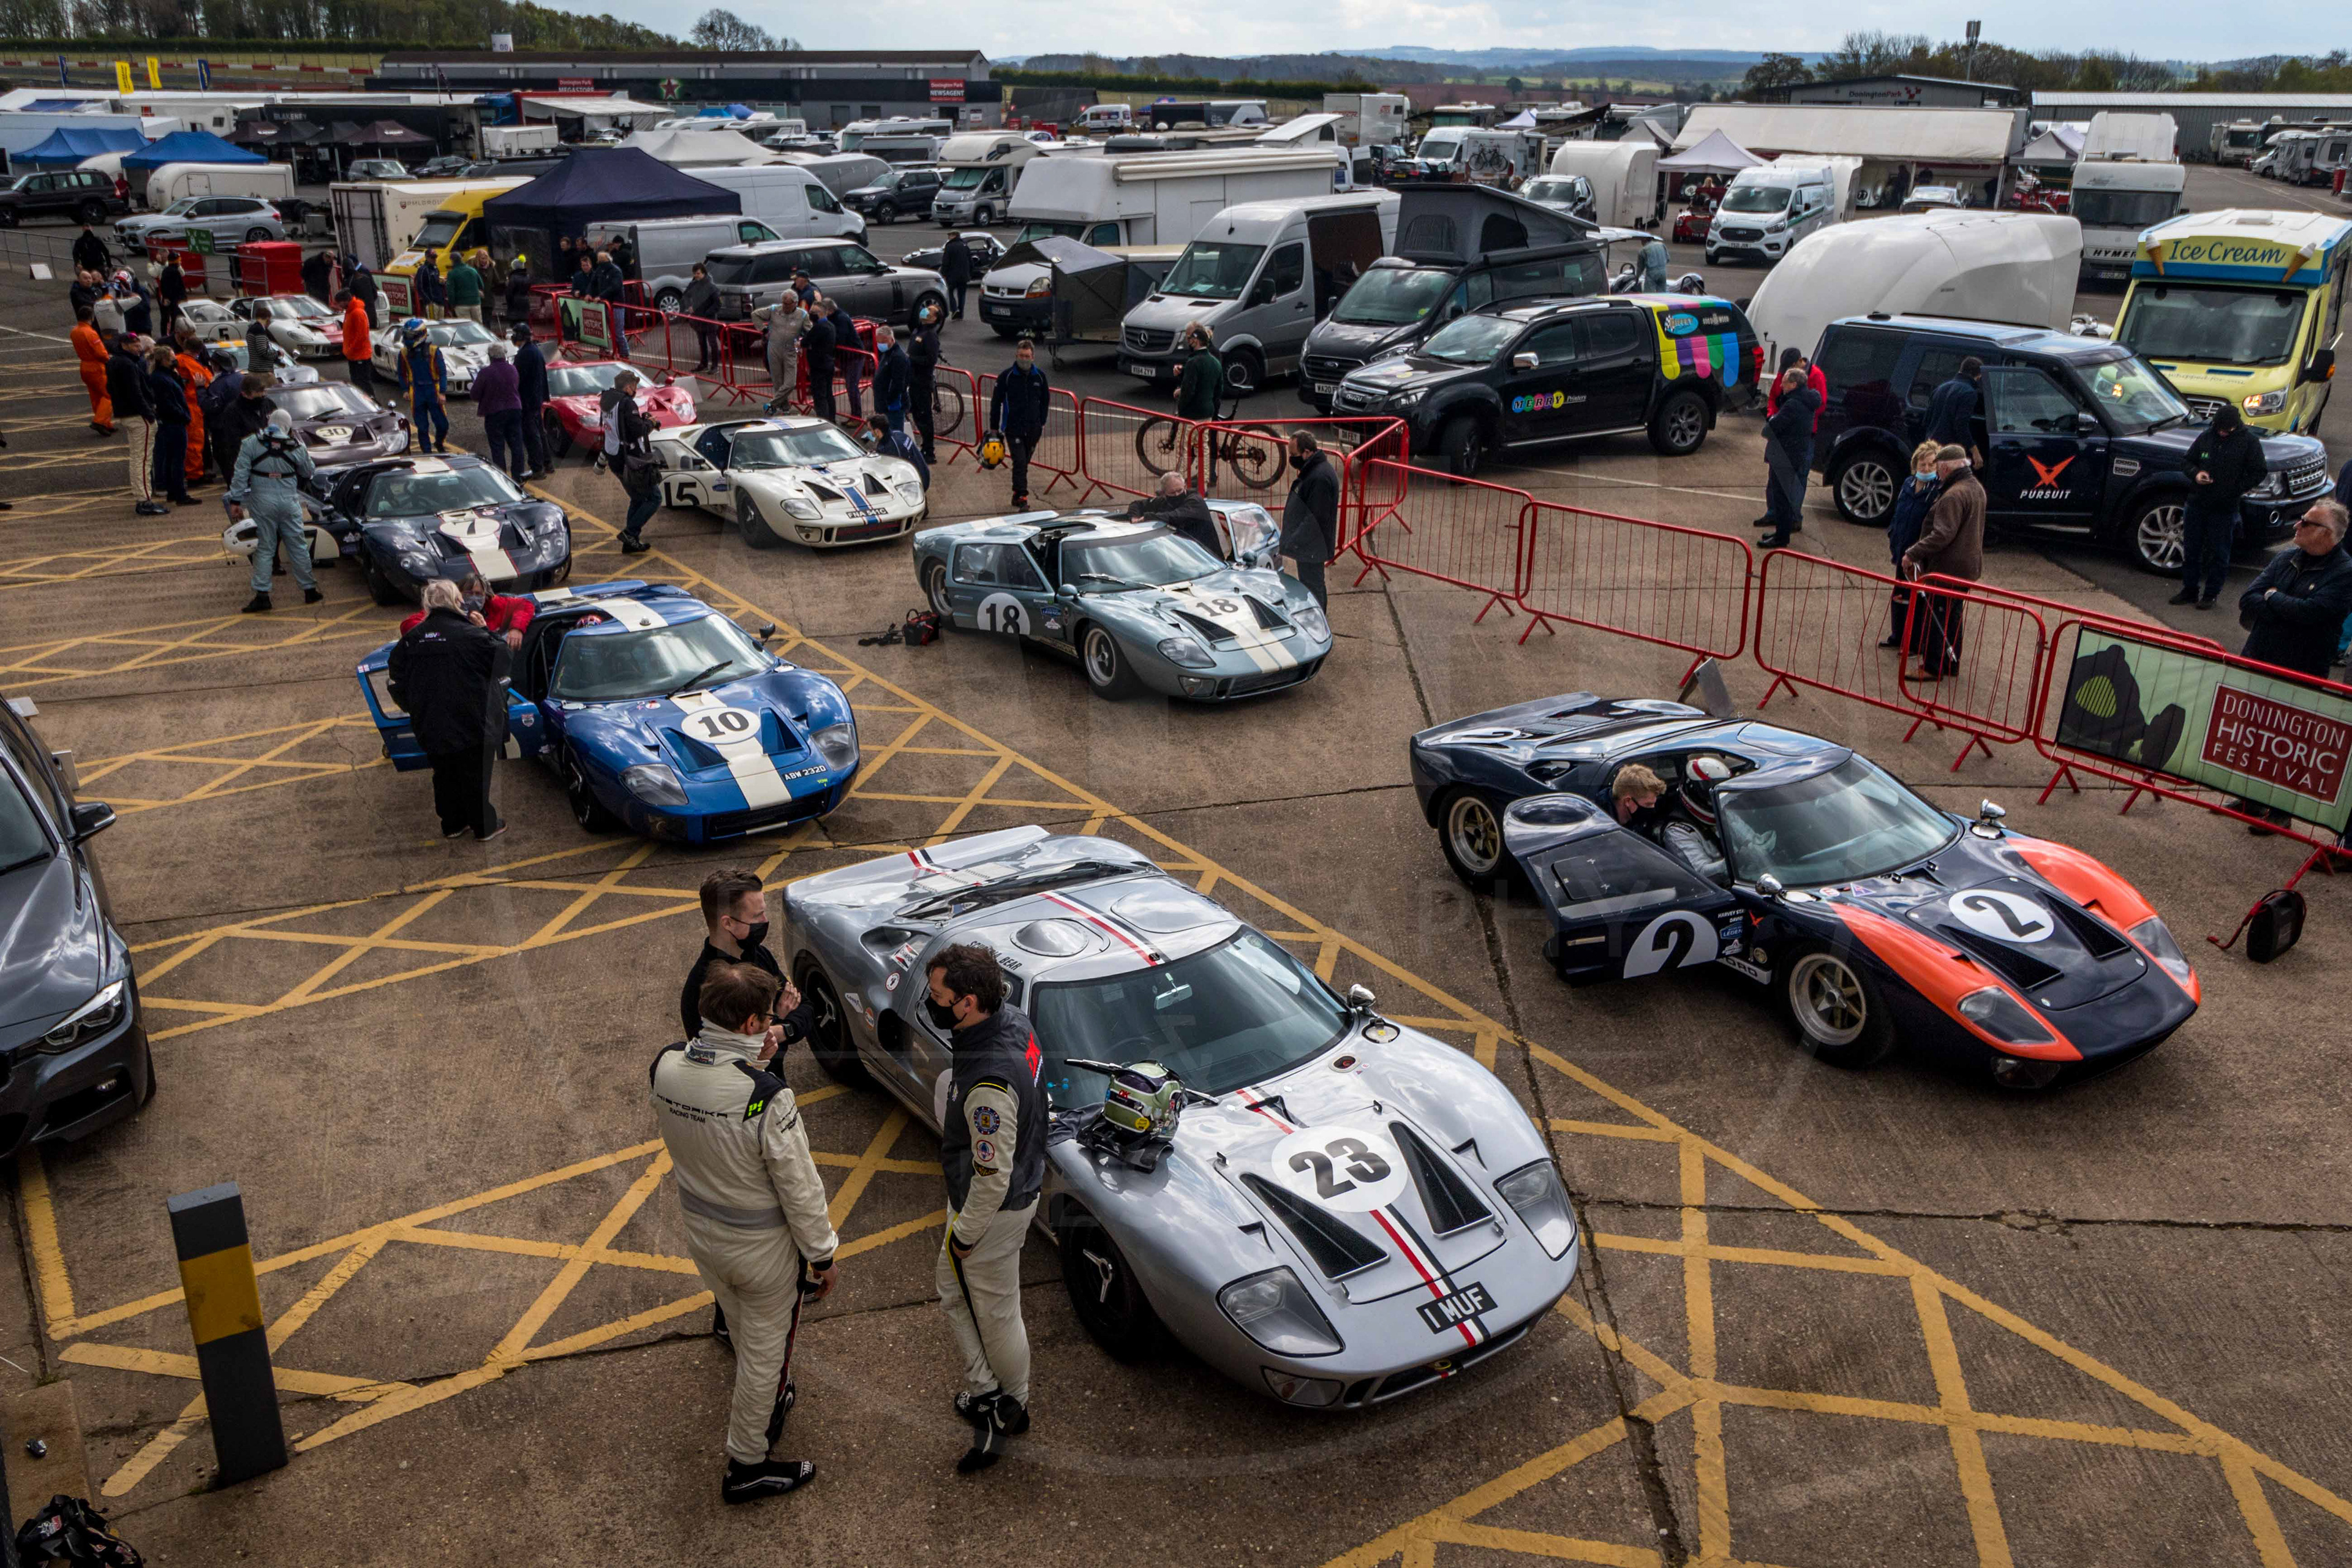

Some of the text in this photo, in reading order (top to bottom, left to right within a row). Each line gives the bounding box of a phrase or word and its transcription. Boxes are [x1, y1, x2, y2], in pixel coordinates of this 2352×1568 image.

[2093, 249, 2136, 258] HYMER
[2169, 241, 2287, 263] Ice Cream
[218, 328, 230, 341] 5
[1513, 393, 1562, 410] MERRY
[320, 428, 347, 437] 30
[664, 482, 700, 507] 15
[2020, 490, 2071, 499] PURSUIT
[986, 603, 1020, 634] 18
[1196, 599, 1238, 617] 18
[698, 711, 749, 738] 10
[2223, 695, 2346, 750] DONINGTON
[2216, 718, 2338, 774] HISTORIC
[785, 765, 826, 781] ABW 232D
[2212, 744, 2328, 794] FESTIVAL
[1962, 895, 2045, 938] 2
[1652, 919, 1695, 973] 2
[999, 956, 1022, 971] BEAR
[1725, 956, 1758, 978] ORD
[669, 1107, 706, 1123] RACING TEAM
[1289, 1137, 1390, 1200] 23
[1438, 1287, 1483, 1322] MUF
